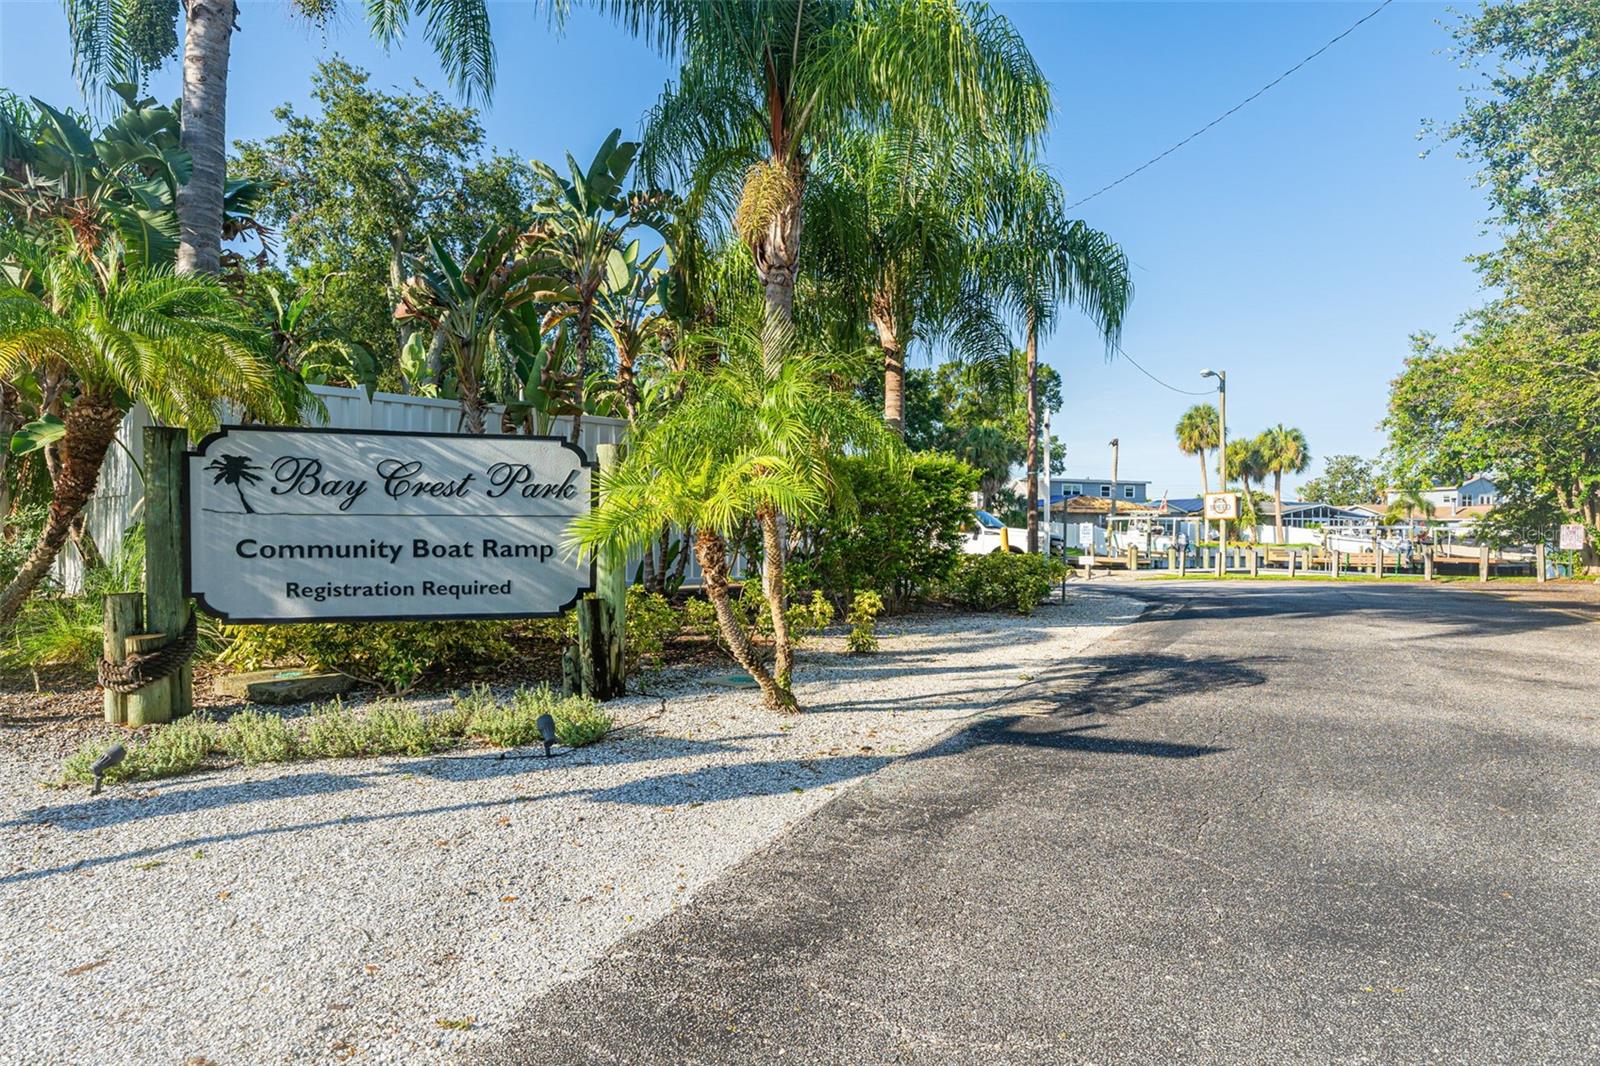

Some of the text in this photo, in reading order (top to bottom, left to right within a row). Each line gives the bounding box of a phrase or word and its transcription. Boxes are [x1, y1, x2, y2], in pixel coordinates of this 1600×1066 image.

[271, 456, 581, 511] Bay Crest Park
[236, 539, 554, 563] Community Boat Ramp
[286, 580, 511, 601] Registration Required
